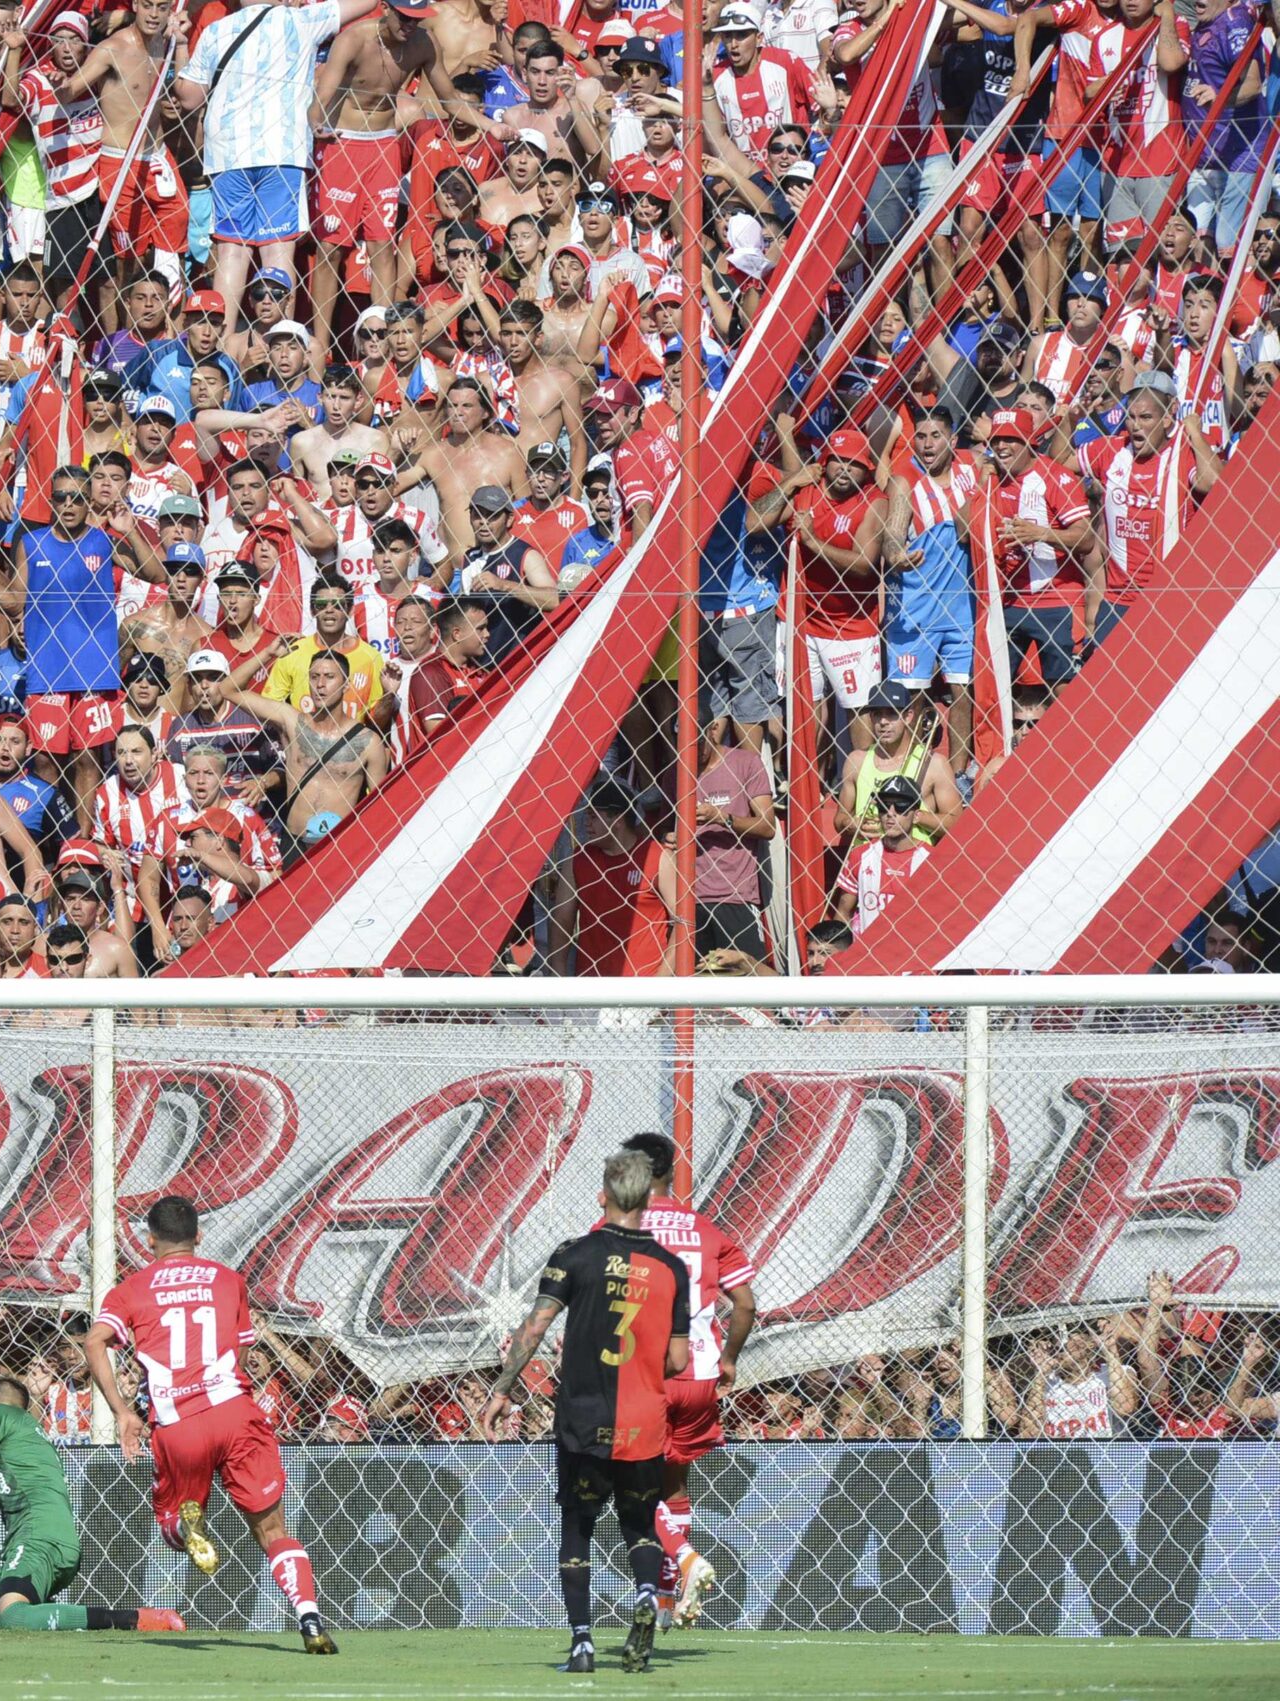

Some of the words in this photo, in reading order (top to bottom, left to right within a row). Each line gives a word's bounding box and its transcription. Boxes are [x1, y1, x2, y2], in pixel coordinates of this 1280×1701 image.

[842, 669, 859, 695] 9
[85, 701, 113, 734] 30
[155, 1285, 214, 1306] GARCÍA
[606, 1281, 650, 1300] PIOVI
[159, 1305, 218, 1370] 11
[599, 1300, 643, 1367] 3
